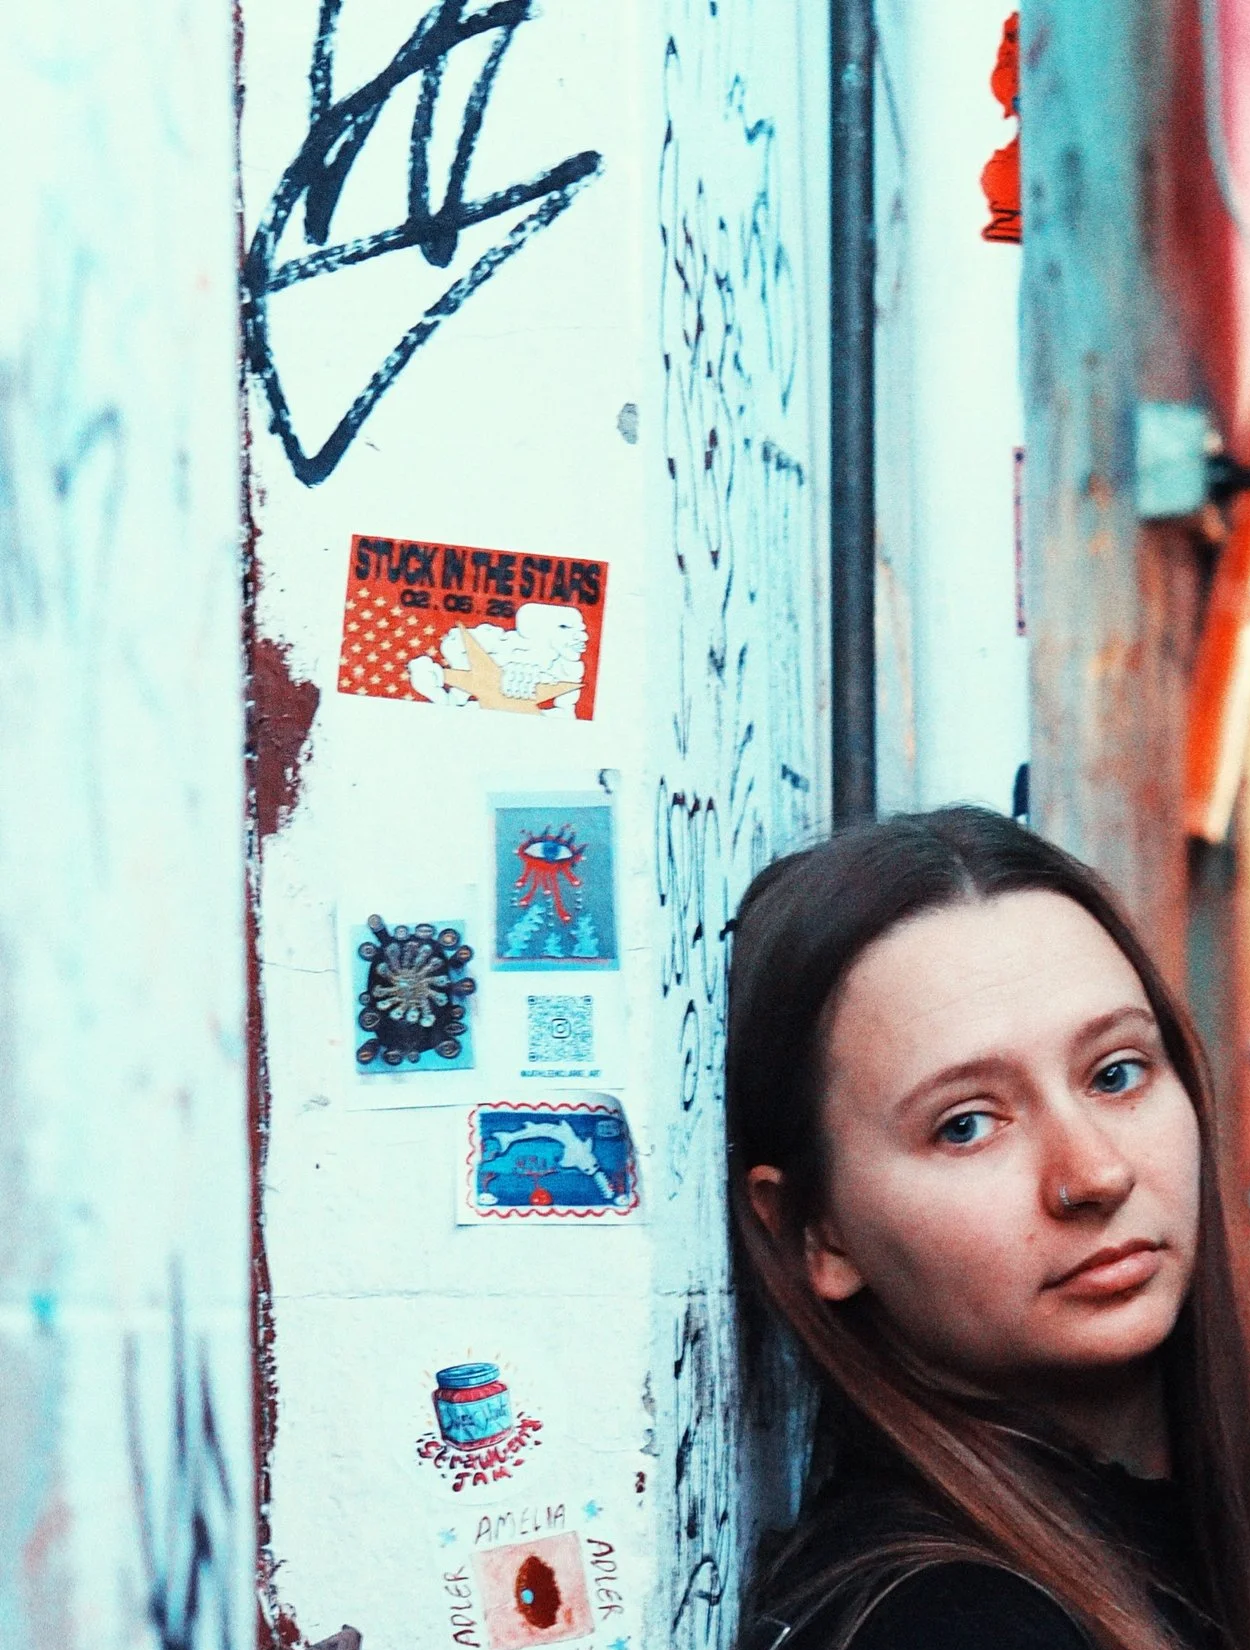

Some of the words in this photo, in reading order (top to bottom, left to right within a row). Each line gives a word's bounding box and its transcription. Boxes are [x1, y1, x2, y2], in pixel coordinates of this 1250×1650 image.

[355, 537, 438, 588] STUCK
[441, 547, 466, 590] IN
[472, 550, 517, 596] THE
[520, 556, 601, 605] STARS
[451, 1466, 513, 1492] JAM
[474, 1503, 566, 1545] AMELIA
[443, 1565, 482, 1648] ADLER
[586, 1537, 625, 1621] ADLER
